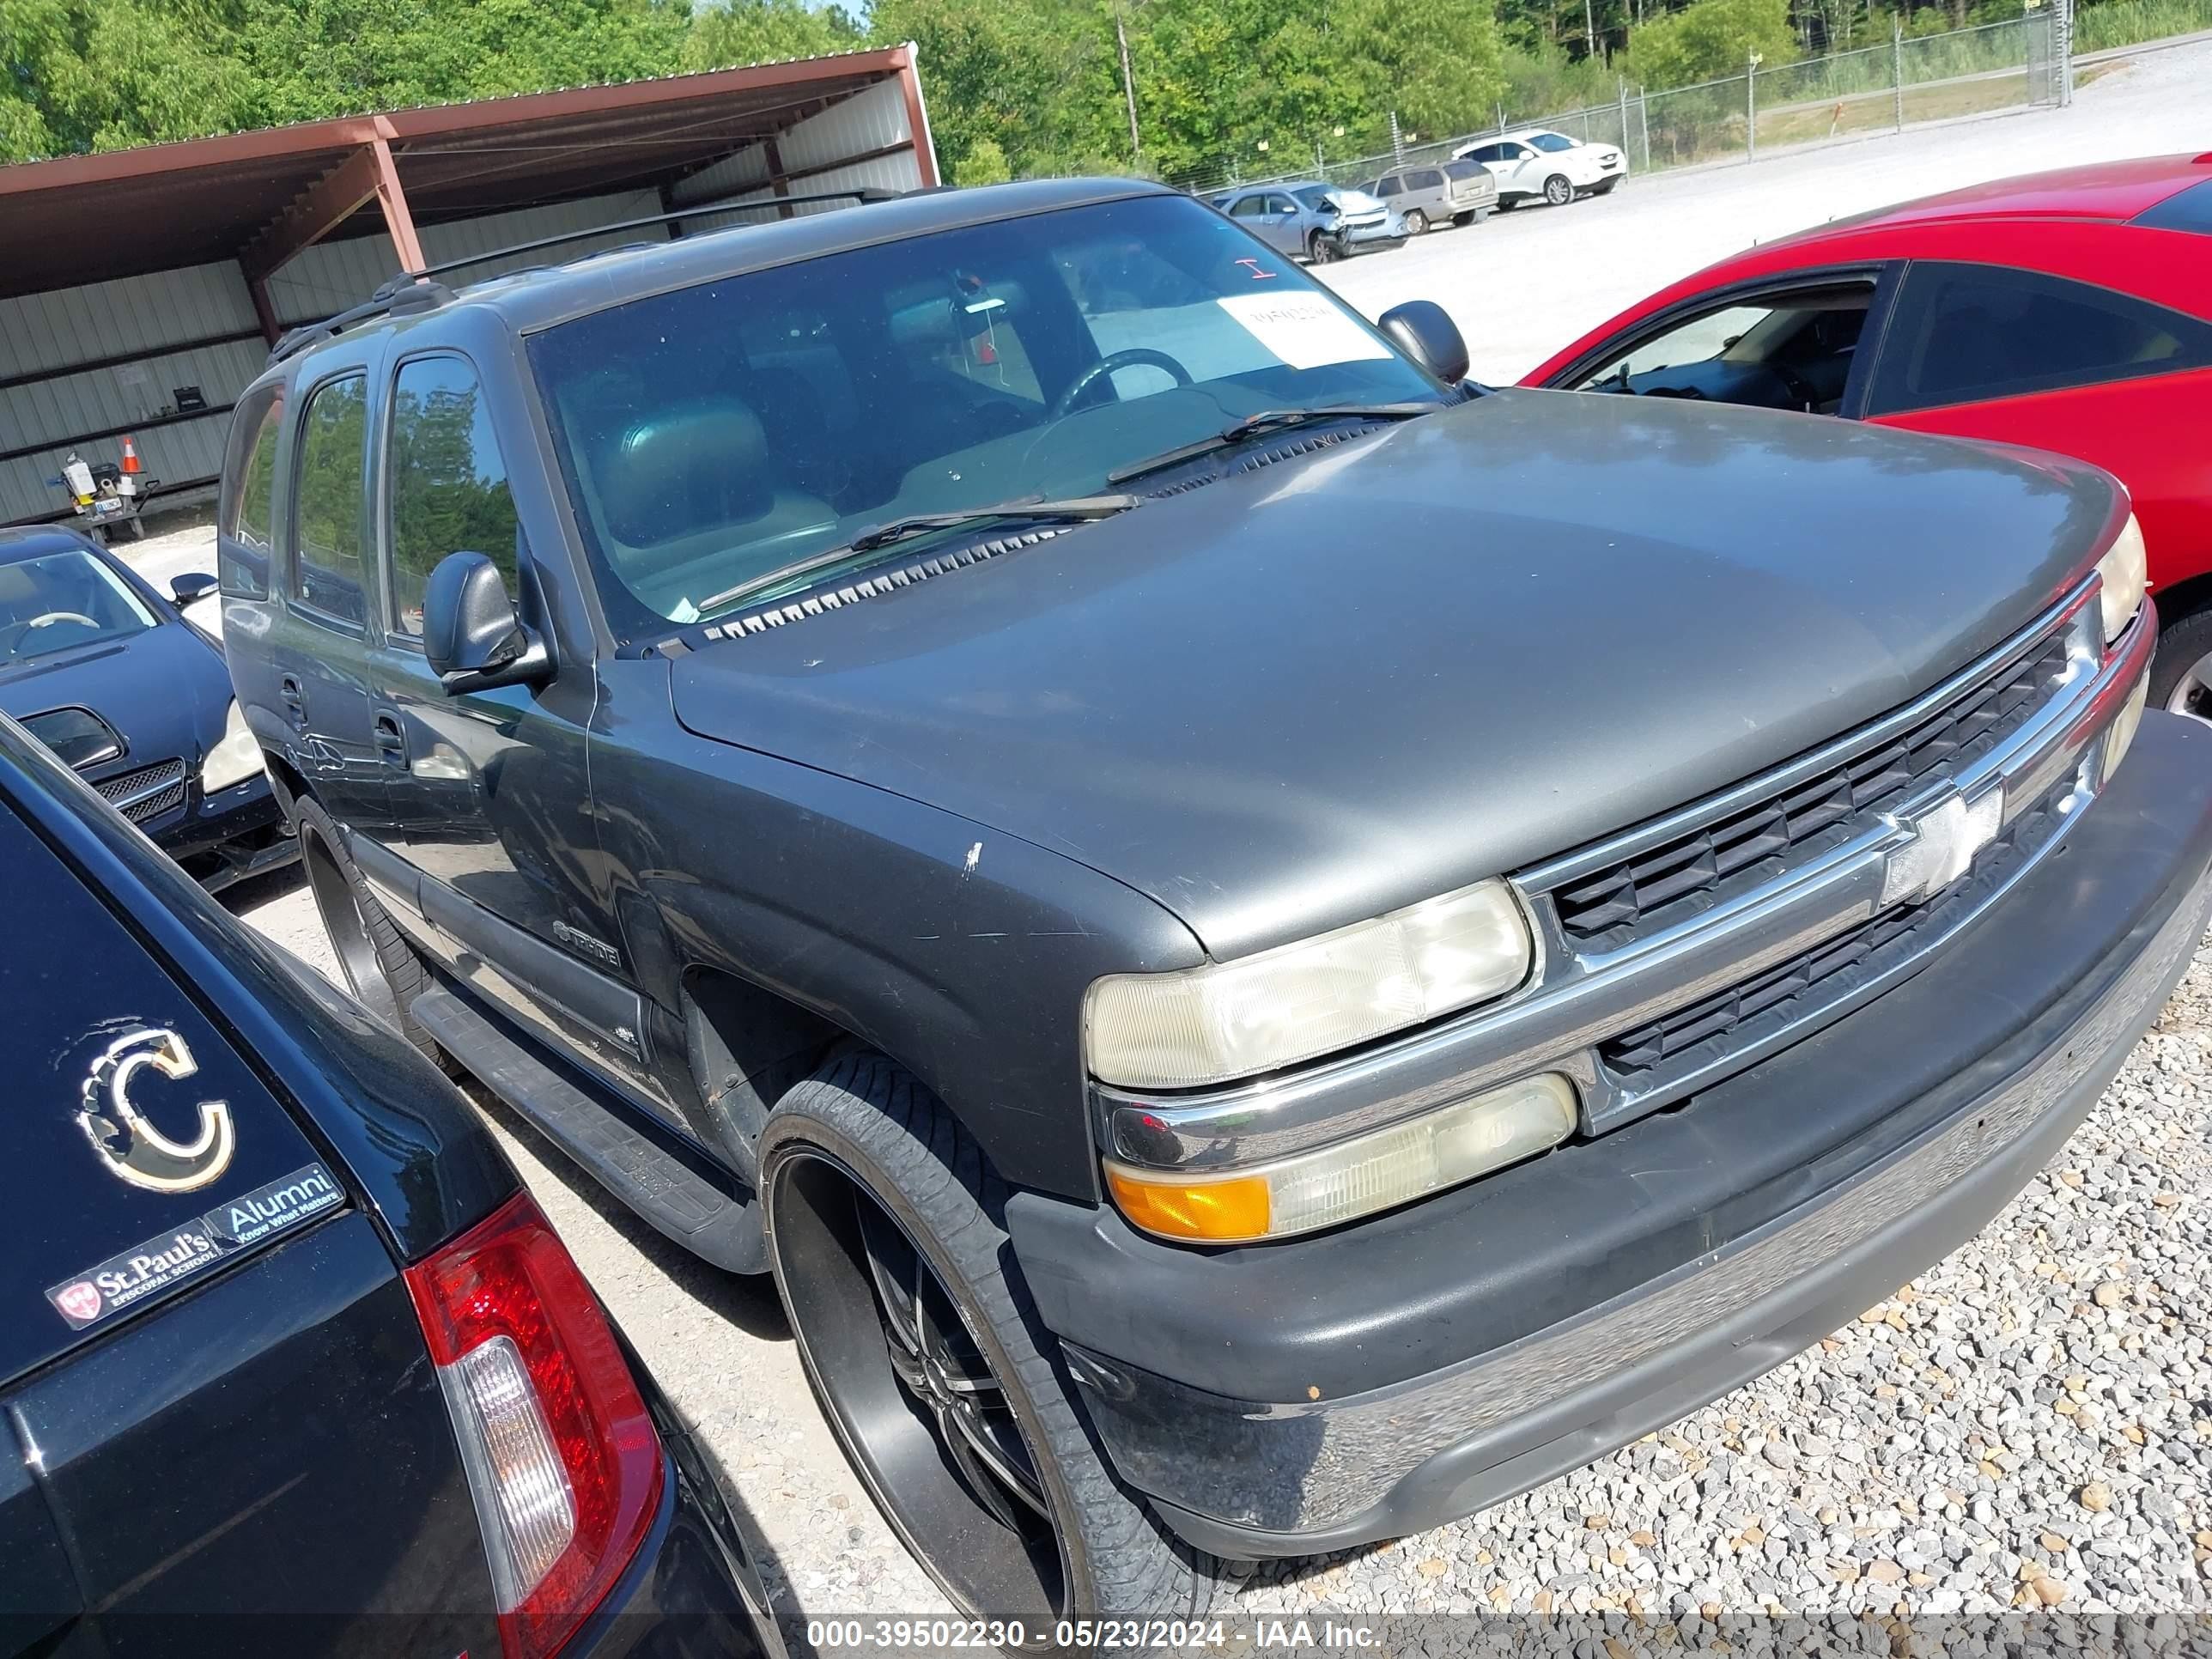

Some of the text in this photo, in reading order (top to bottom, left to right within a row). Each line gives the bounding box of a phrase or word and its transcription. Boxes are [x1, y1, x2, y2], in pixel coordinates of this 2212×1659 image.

[231, 1169, 332, 1233] Alumni
[237, 1192, 338, 1243] Know What Matters
[111, 1251, 217, 1307] EPISCOPAL SCHOOL
